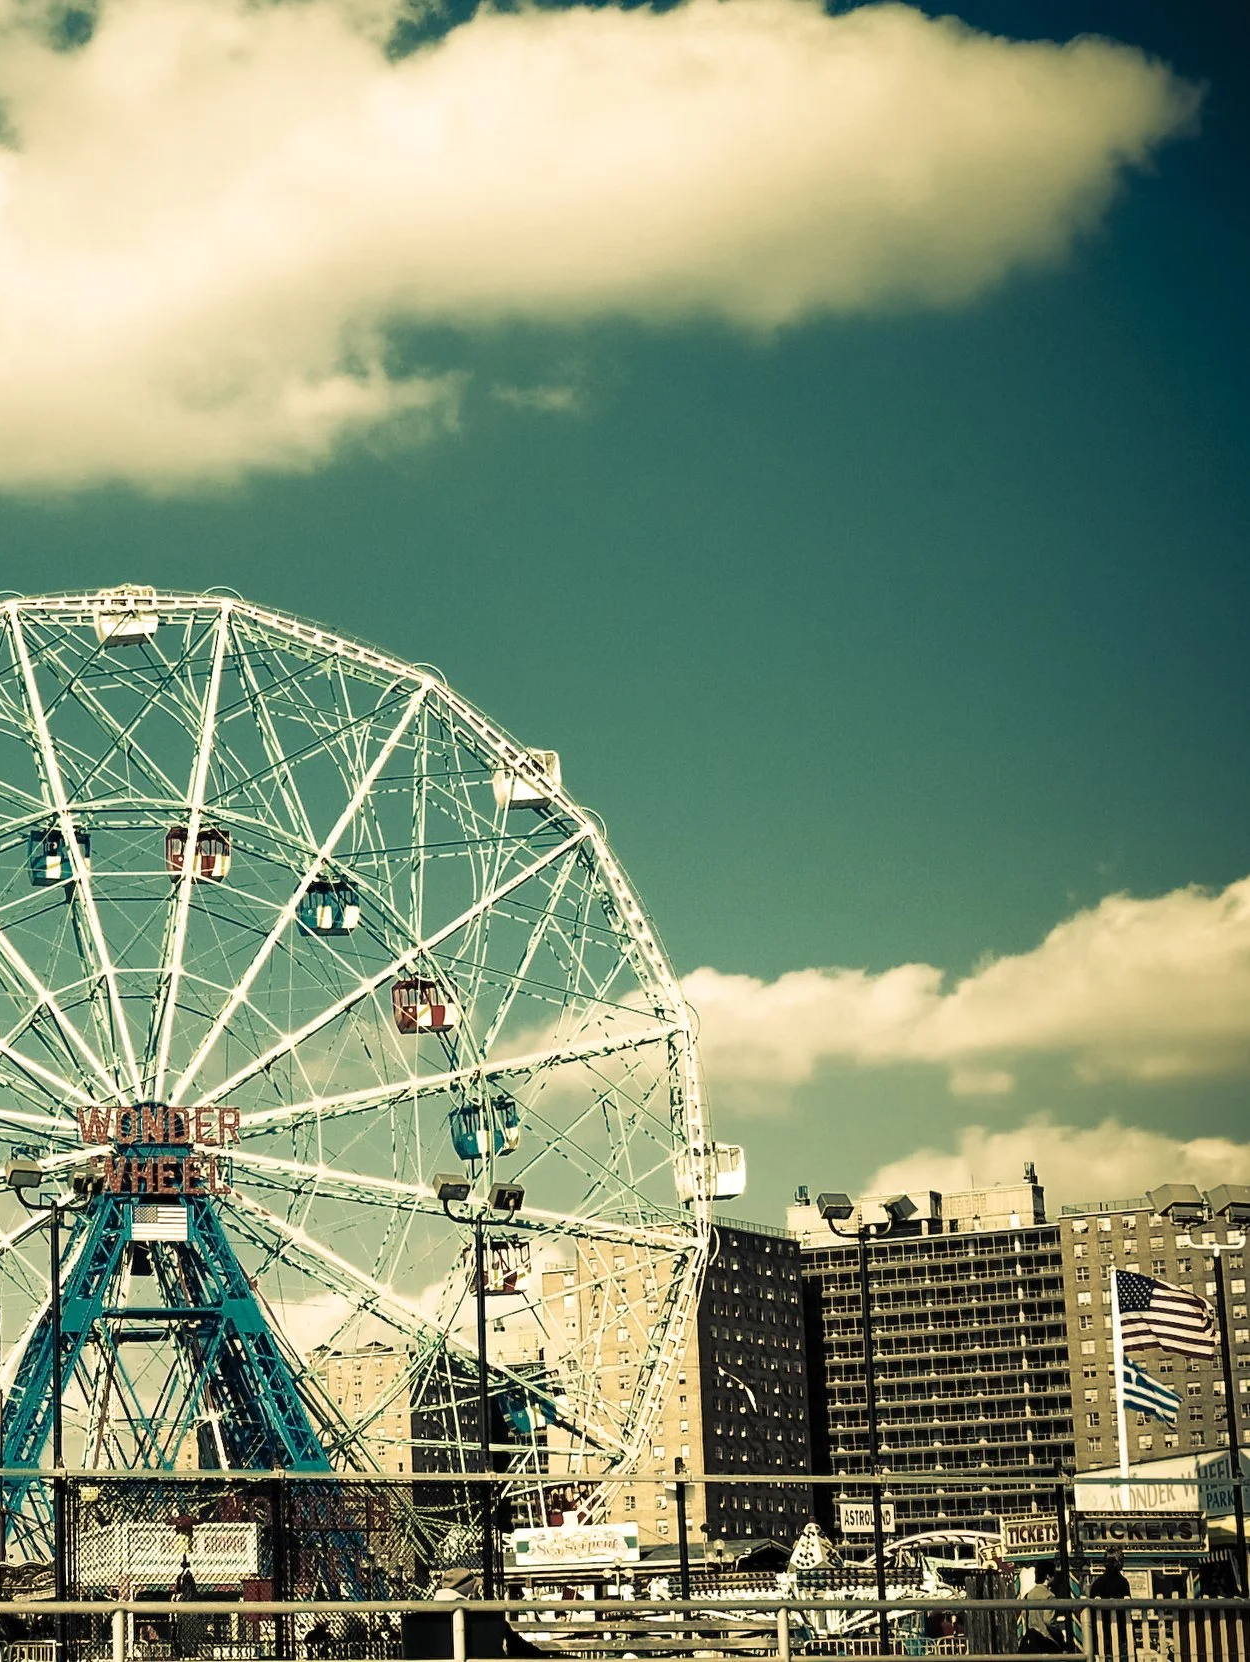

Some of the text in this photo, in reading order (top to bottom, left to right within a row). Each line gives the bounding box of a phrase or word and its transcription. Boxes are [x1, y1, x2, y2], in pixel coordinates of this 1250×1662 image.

[77, 1106, 240, 1145] WONDER
[90, 1156, 232, 1194] WHEEL
[1206, 1490, 1235, 1510] PARK
[845, 1509, 891, 1526] ASTROLND
[1007, 1522, 1059, 1545] TICKETS
[1083, 1521, 1193, 1541] TICKETS
[565, 1538, 618, 1554] Serpent
